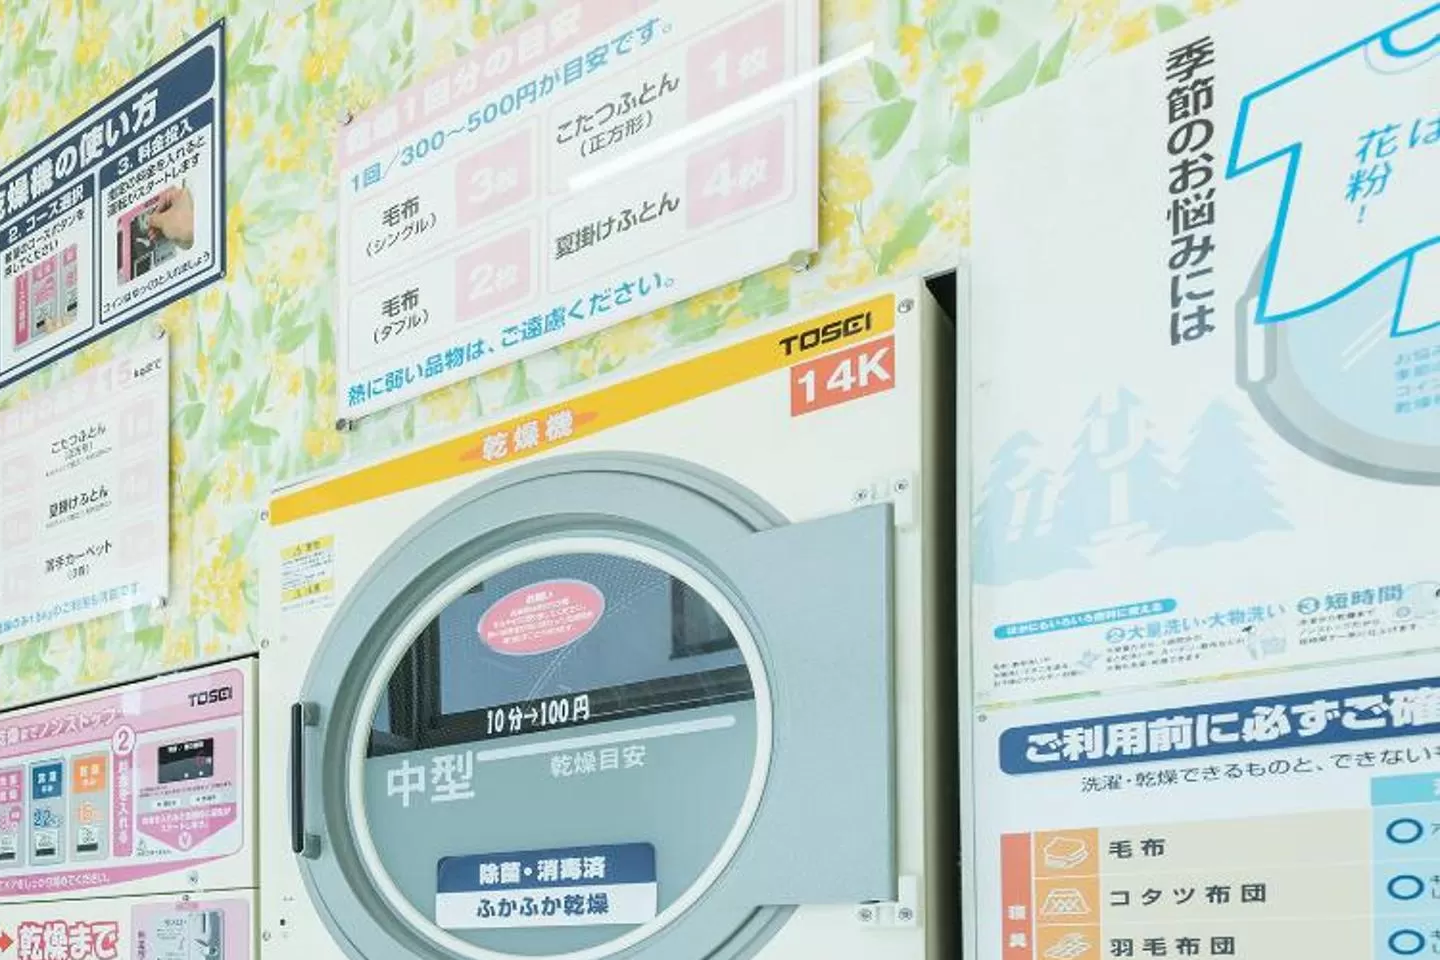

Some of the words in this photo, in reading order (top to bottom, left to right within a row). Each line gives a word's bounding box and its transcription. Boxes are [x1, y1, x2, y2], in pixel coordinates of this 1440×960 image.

[556, 73, 680, 145] こたつふとん
[1164, 36, 1216, 347] 季節のお悩みには
[381, 197, 420, 227] 毛布
[555, 192, 681, 260] 夏掛けふとん
[381, 288, 420, 319] 毛布
[347, 272, 674, 408] 熱に弱い品物は、ご遠慮ください。
[779, 312, 872, 358] TOSEI
[796, 348, 892, 404] 14K
[482, 411, 574, 461] 乾燥機
[188, 685, 234, 708] TOSEI
[1025, 687, 1440, 764] ご利用前に必ずご確
[386, 750, 475, 808] 中型
[549, 744, 648, 778] 乾燥目安
[1109, 838, 1166, 859] 毛布
[478, 855, 607, 886] 除菌・消毒済
[476, 892, 610, 919] ふかふか乾燥
[1109, 882, 1267, 907] コタツ布団
[1110, 935, 1236, 957] 羽毛布団
